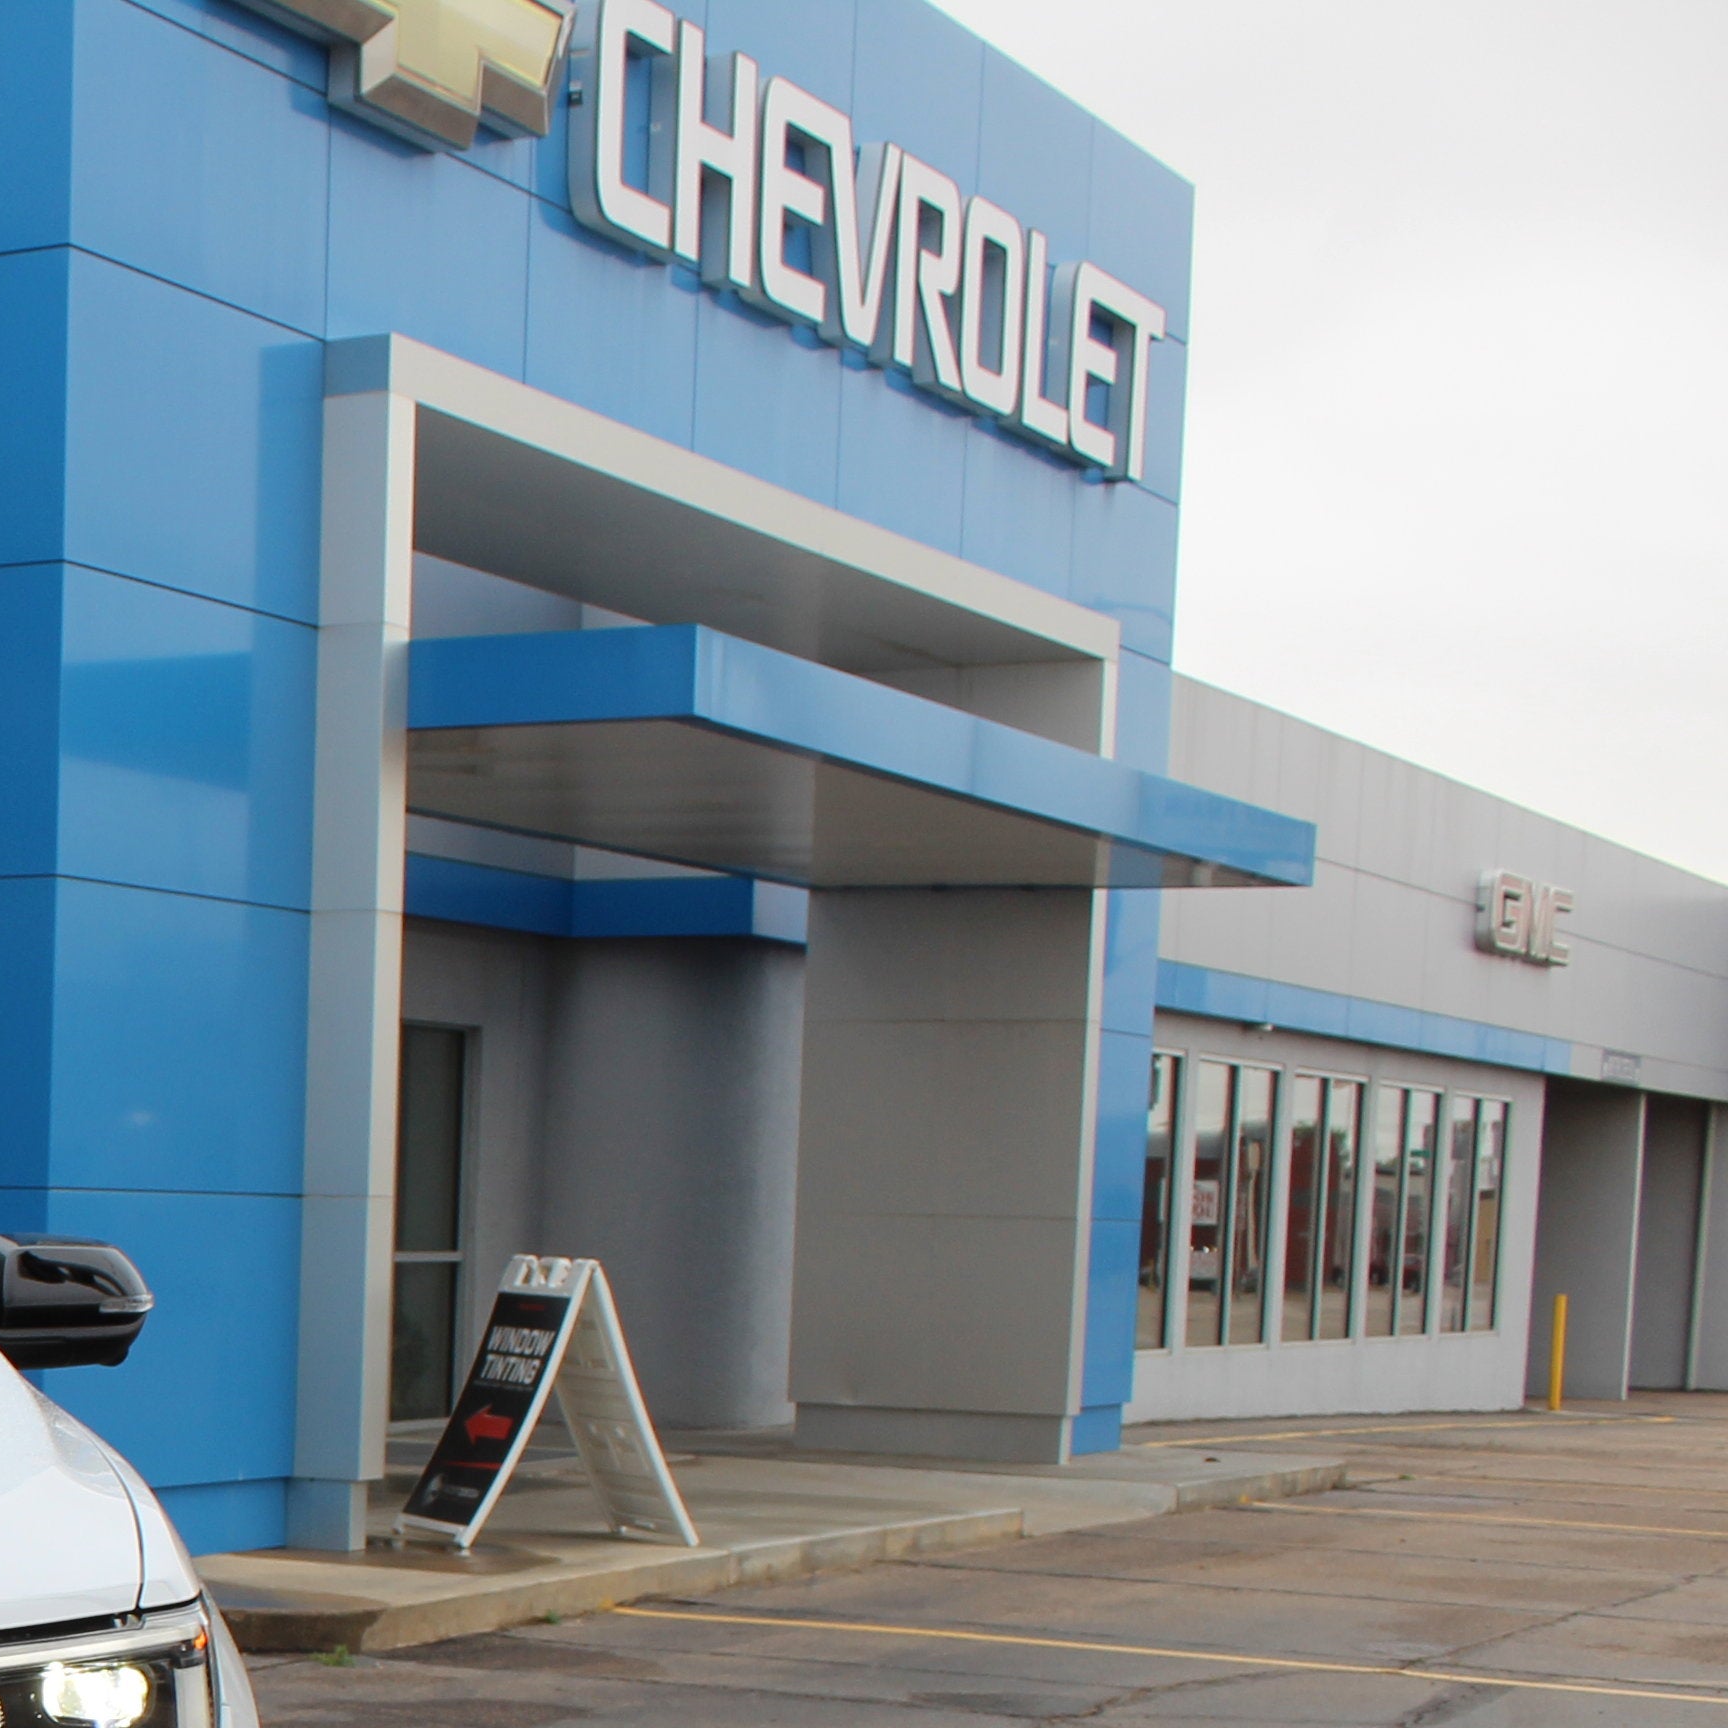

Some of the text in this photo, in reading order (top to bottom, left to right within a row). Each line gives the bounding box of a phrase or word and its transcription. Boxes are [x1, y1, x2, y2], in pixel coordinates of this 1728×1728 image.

[584, 0, 1166, 482] CHEVROLET
[488, 1327, 555, 1354] WINDOW
[481, 1355, 541, 1384] TINTING
